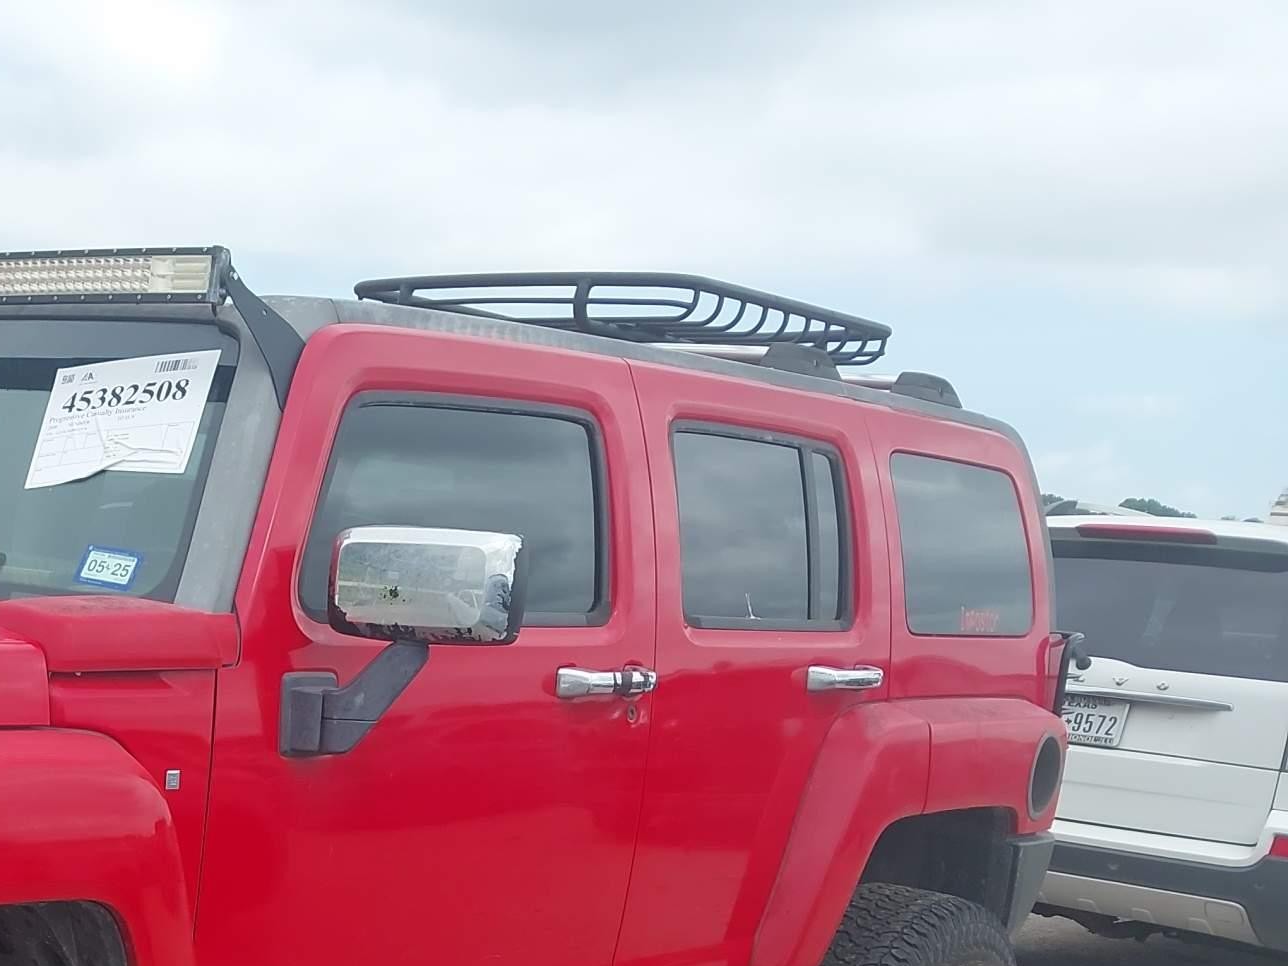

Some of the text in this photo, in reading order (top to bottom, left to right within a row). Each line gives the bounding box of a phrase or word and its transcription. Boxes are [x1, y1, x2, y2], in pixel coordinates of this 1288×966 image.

[62, 378, 190, 413] 45382508
[87, 558, 132, 578] 05 25
